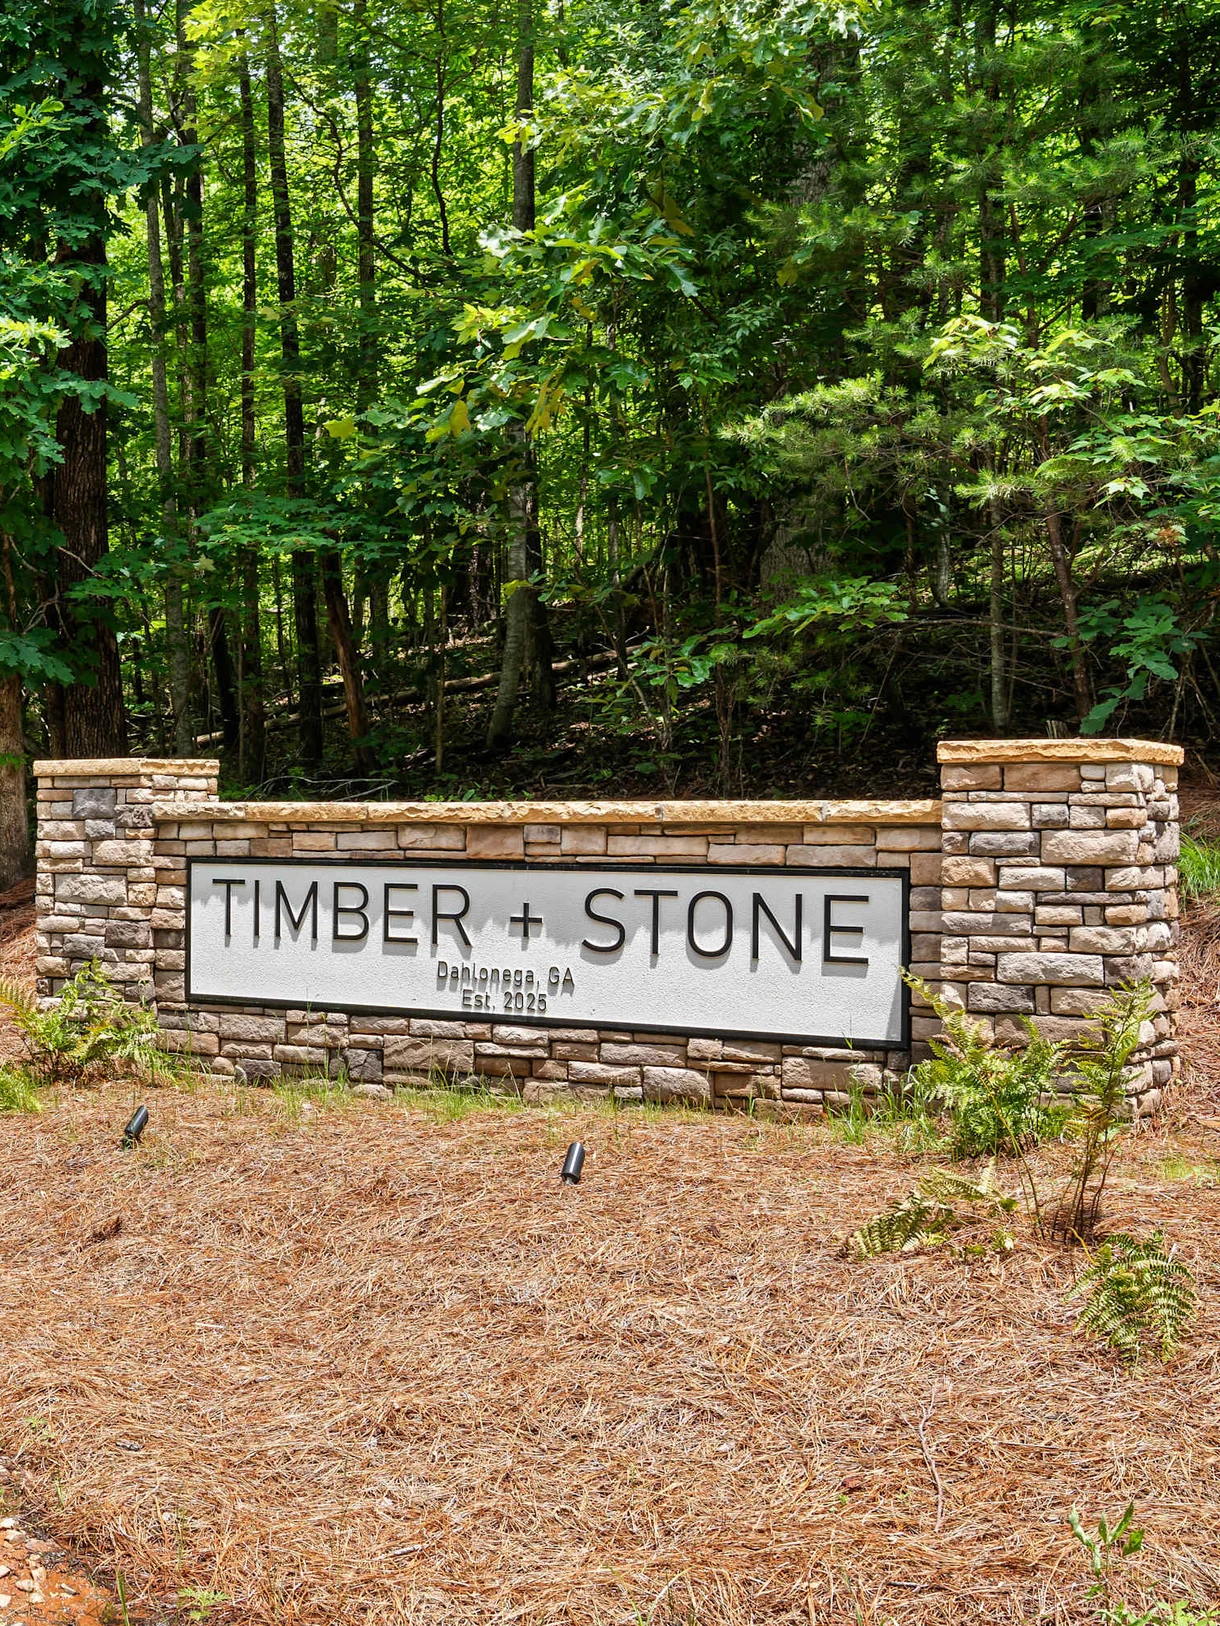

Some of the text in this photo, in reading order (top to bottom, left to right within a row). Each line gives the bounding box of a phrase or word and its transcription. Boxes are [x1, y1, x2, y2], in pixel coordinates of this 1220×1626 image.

[212, 878, 870, 965] TIMBER + STONE
[437, 961, 575, 989] Dahlonega, GA
[504, 991, 547, 1011] 2025
